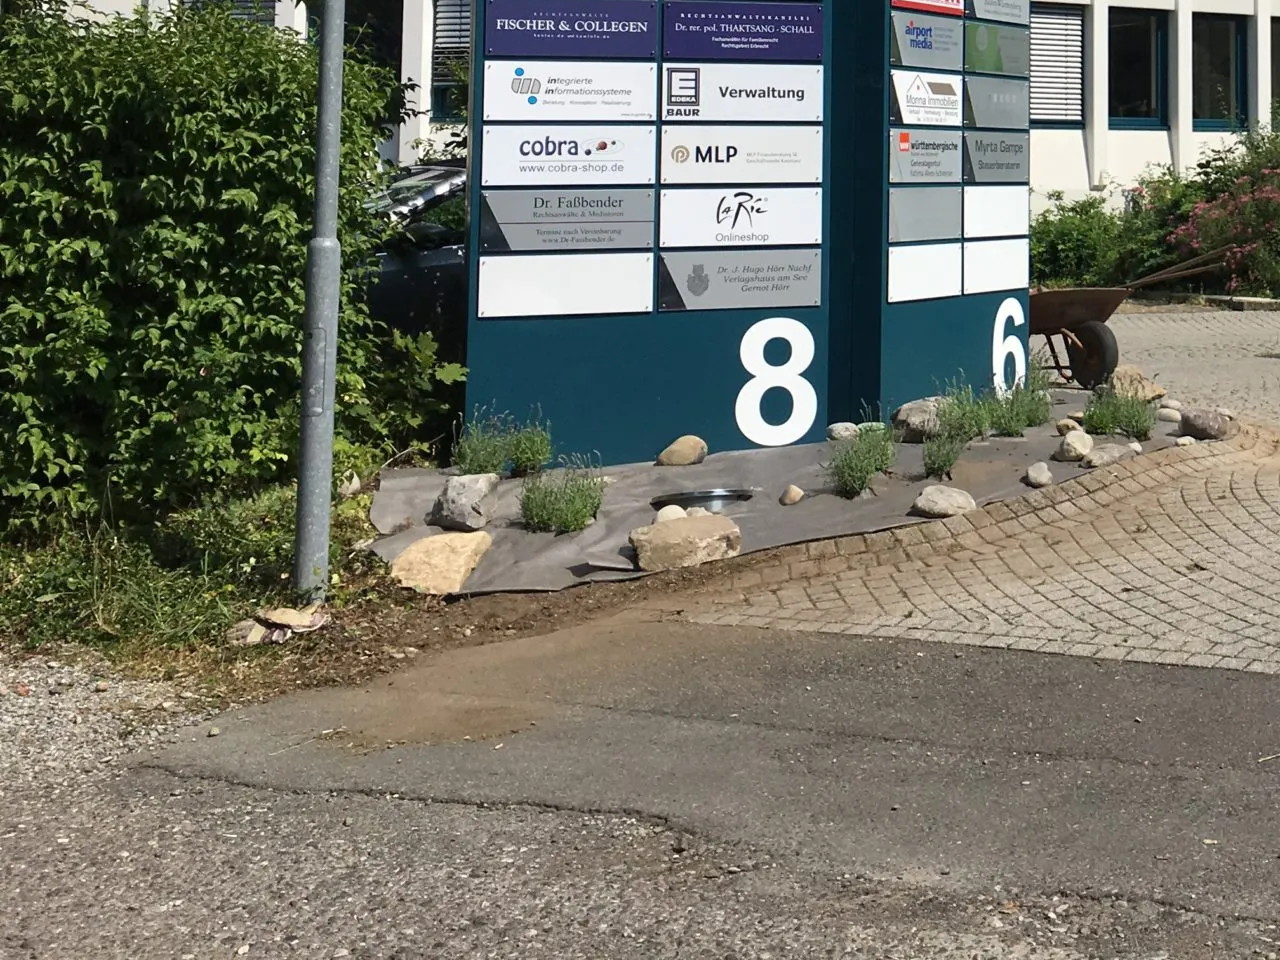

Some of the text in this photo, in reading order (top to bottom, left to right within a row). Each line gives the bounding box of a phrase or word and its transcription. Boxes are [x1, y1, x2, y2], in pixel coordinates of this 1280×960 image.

[496, 19, 648, 33] FISCHER & COLLEGEN
[675, 23, 688, 31] Dr.
[719, 24, 775, 33] THAKTSANG
[780, 25, 815, 34] SCHALL
[905, 24, 933, 39] airport
[910, 38, 933, 50] media
[547, 76, 593, 87] integrierte
[544, 87, 632, 96] informationssysteme
[719, 86, 805, 101] Verwaltung
[667, 108, 700, 117] BAUR
[519, 136, 578, 156] cobra
[695, 145, 738, 163] MLP
[519, 163, 624, 173] www.cobra-shop.de
[533, 196, 624, 209] Dr. Faßbender
[715, 232, 769, 243] Onlineshop
[992, 297, 1027, 401] 6
[734, 317, 818, 447] 8
